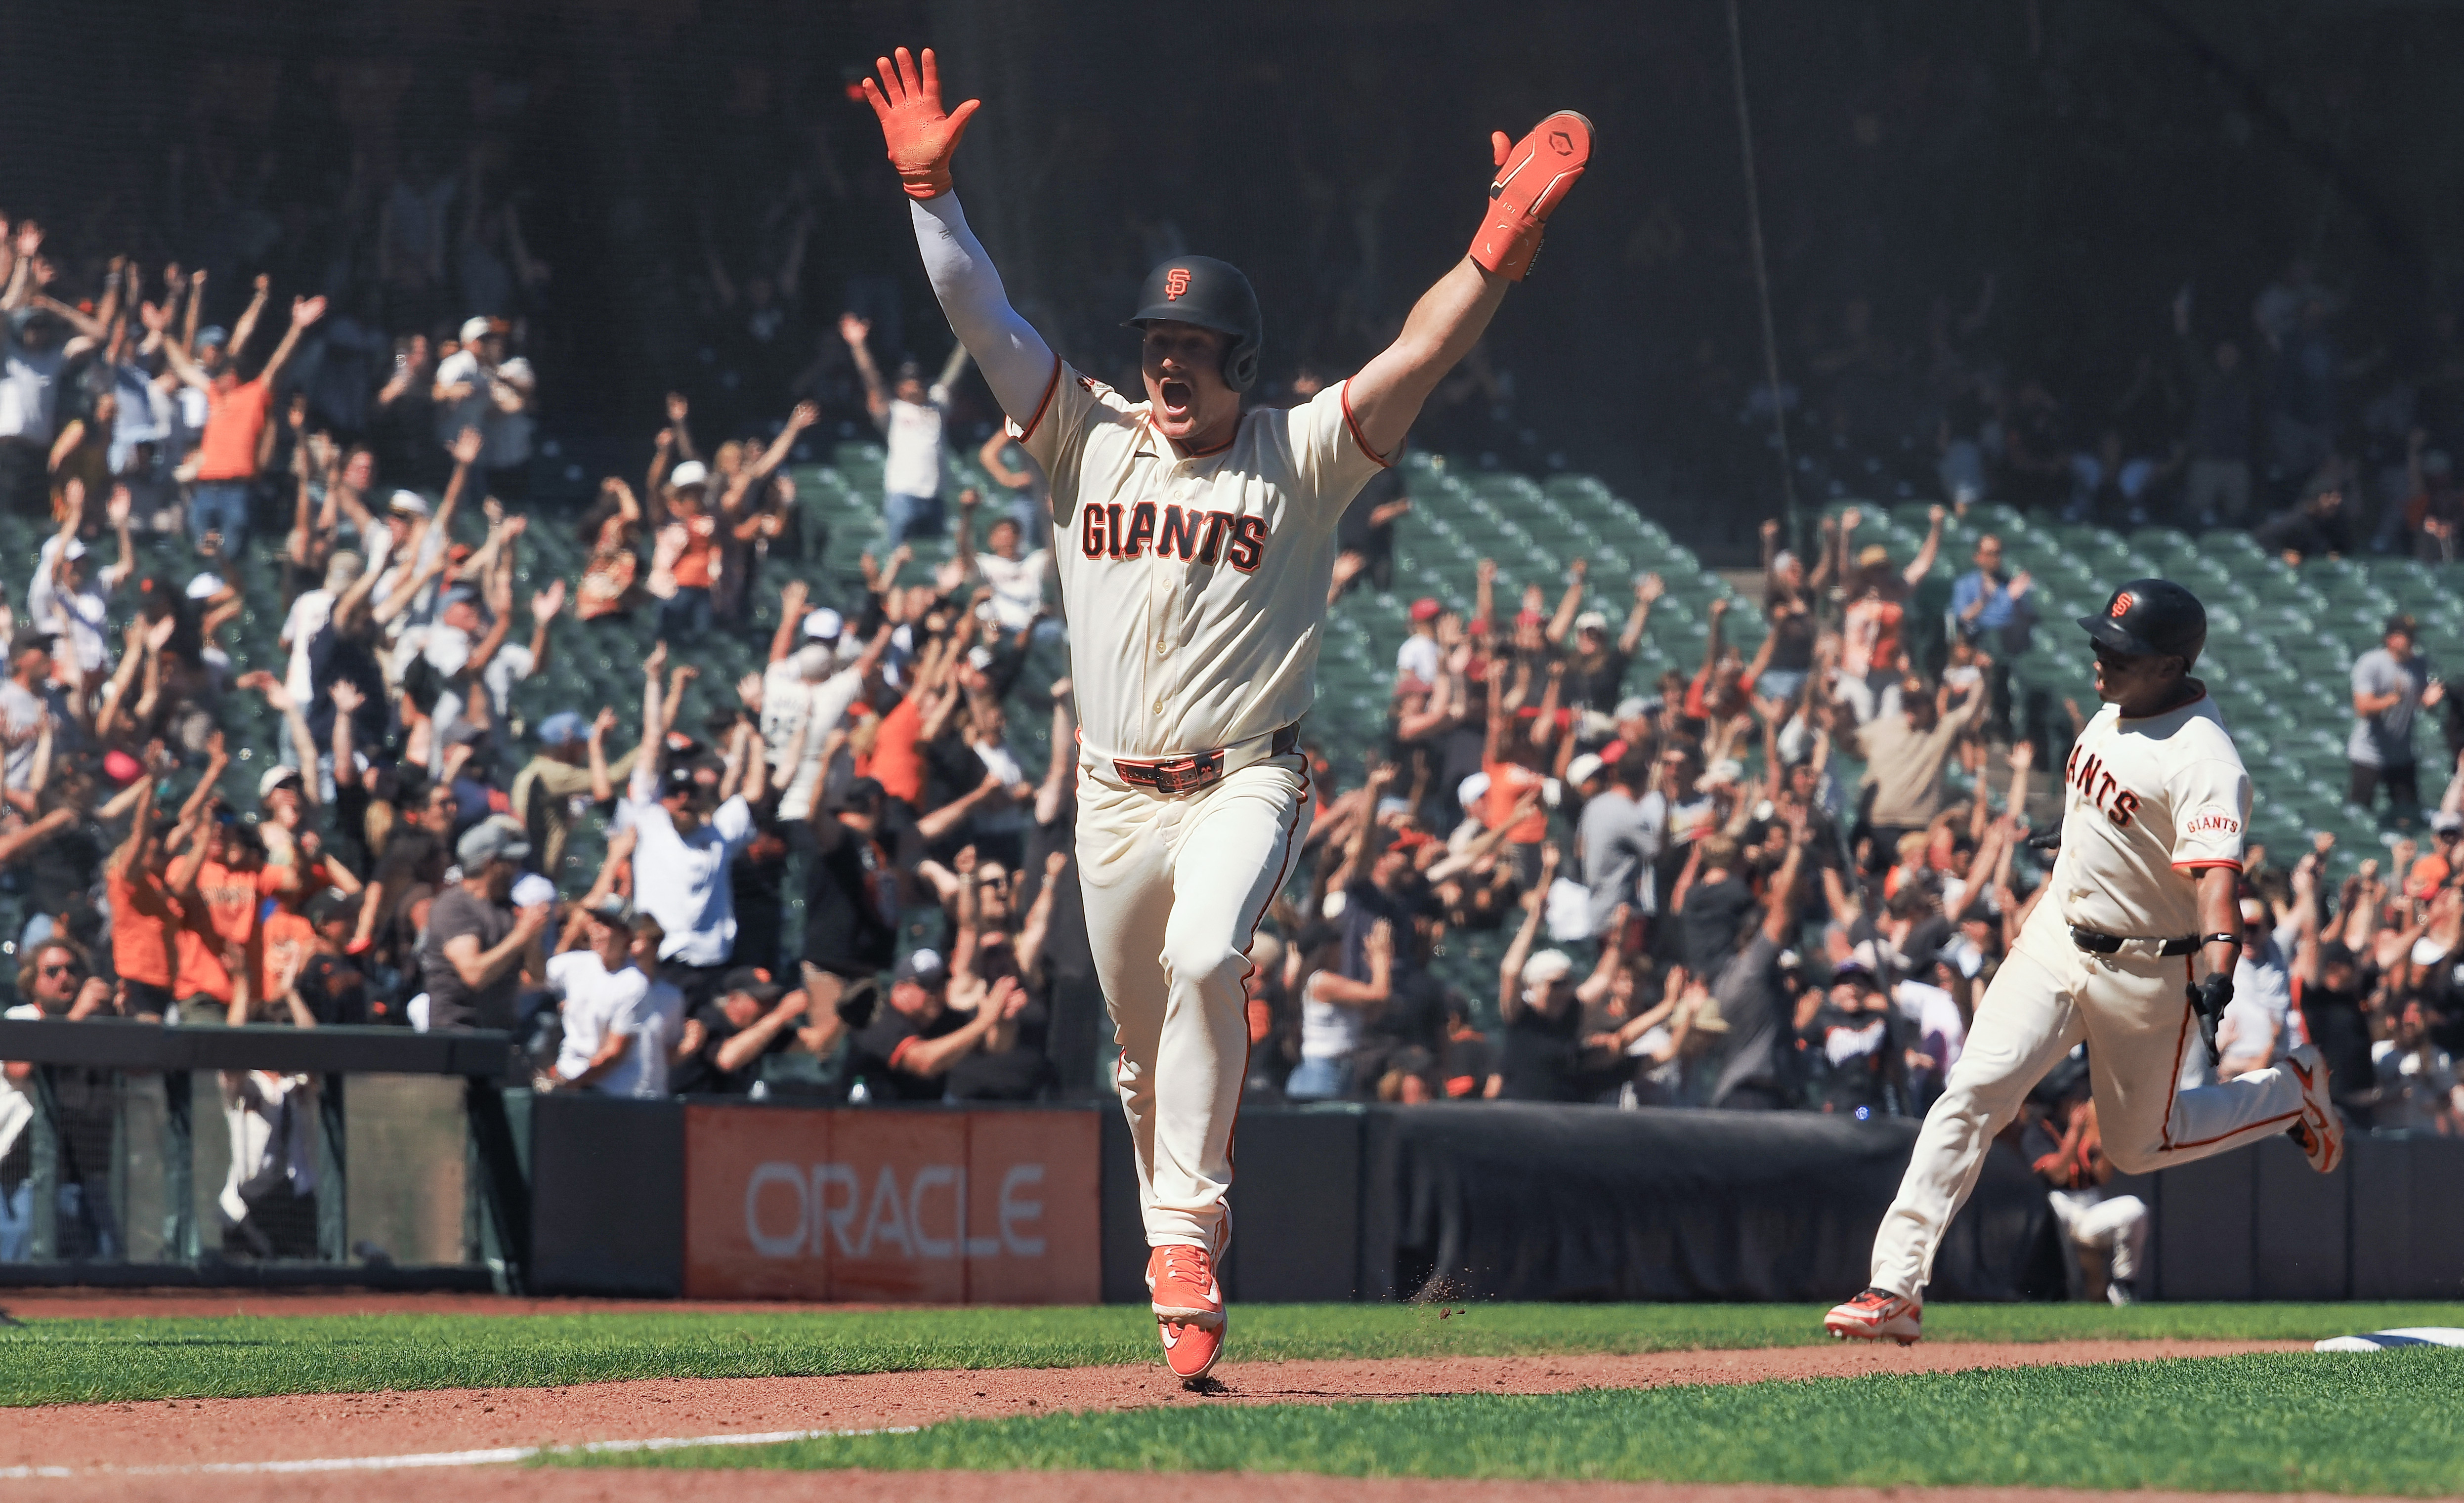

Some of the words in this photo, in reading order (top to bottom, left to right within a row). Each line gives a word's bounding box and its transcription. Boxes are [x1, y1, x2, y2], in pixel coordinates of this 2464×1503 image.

[1165, 268, 1191, 301] SF
[1082, 501, 1269, 573] GIANTS
[2111, 592, 2133, 618] SF
[2187, 817, 2238, 833] GIANTS
[745, 1162, 1046, 1259] ORACLE
